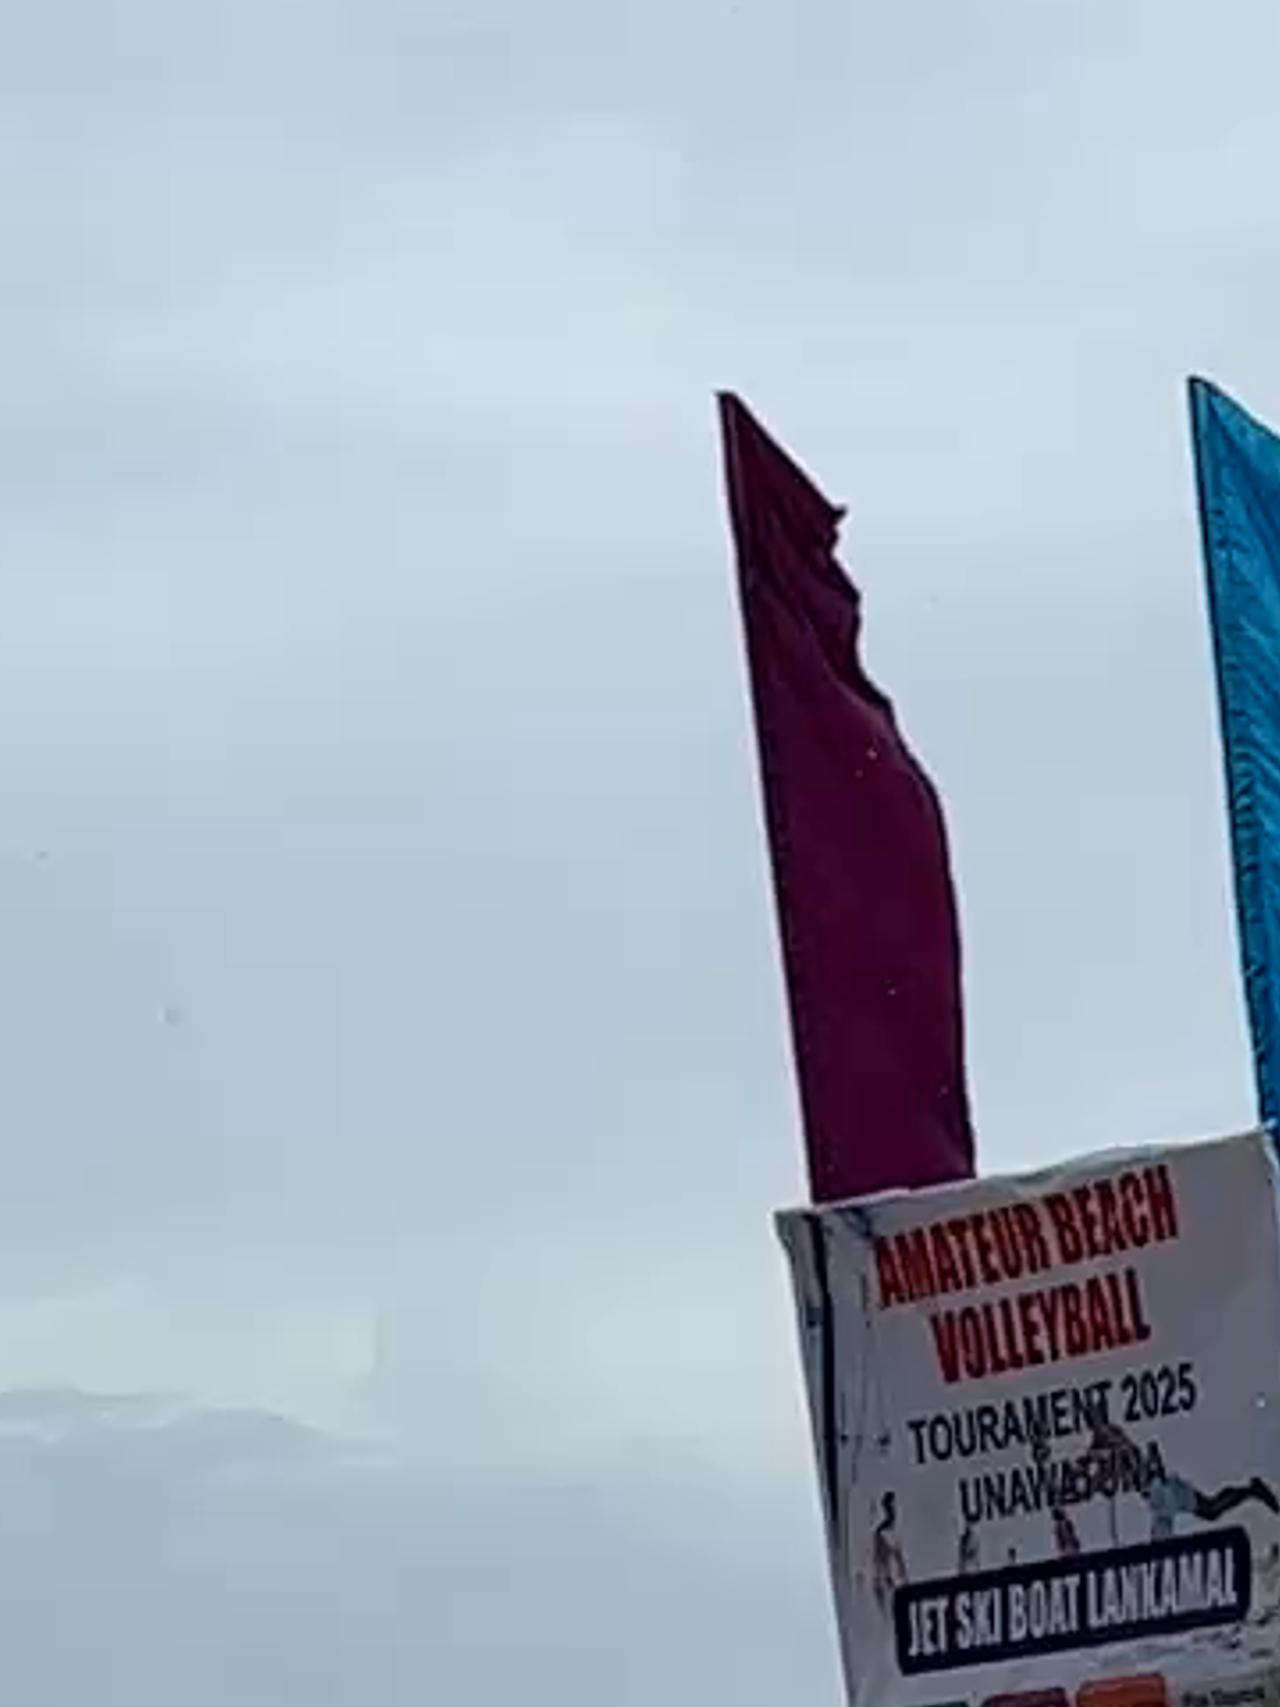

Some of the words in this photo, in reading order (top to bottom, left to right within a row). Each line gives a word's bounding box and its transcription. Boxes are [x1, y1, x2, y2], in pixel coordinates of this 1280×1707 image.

[876, 1203, 1051, 1311] AMATEUR
[1043, 1165, 1178, 1265] BEACH
[930, 1267, 1151, 1383] VOLLEYBALL
[907, 1380, 1112, 1464] TOURAMENT
[1122, 1363, 1196, 1422] 2025
[908, 1597, 949, 1657] JET
[955, 1587, 1003, 1650] SKI
[1008, 1574, 1081, 1642] BOAT
